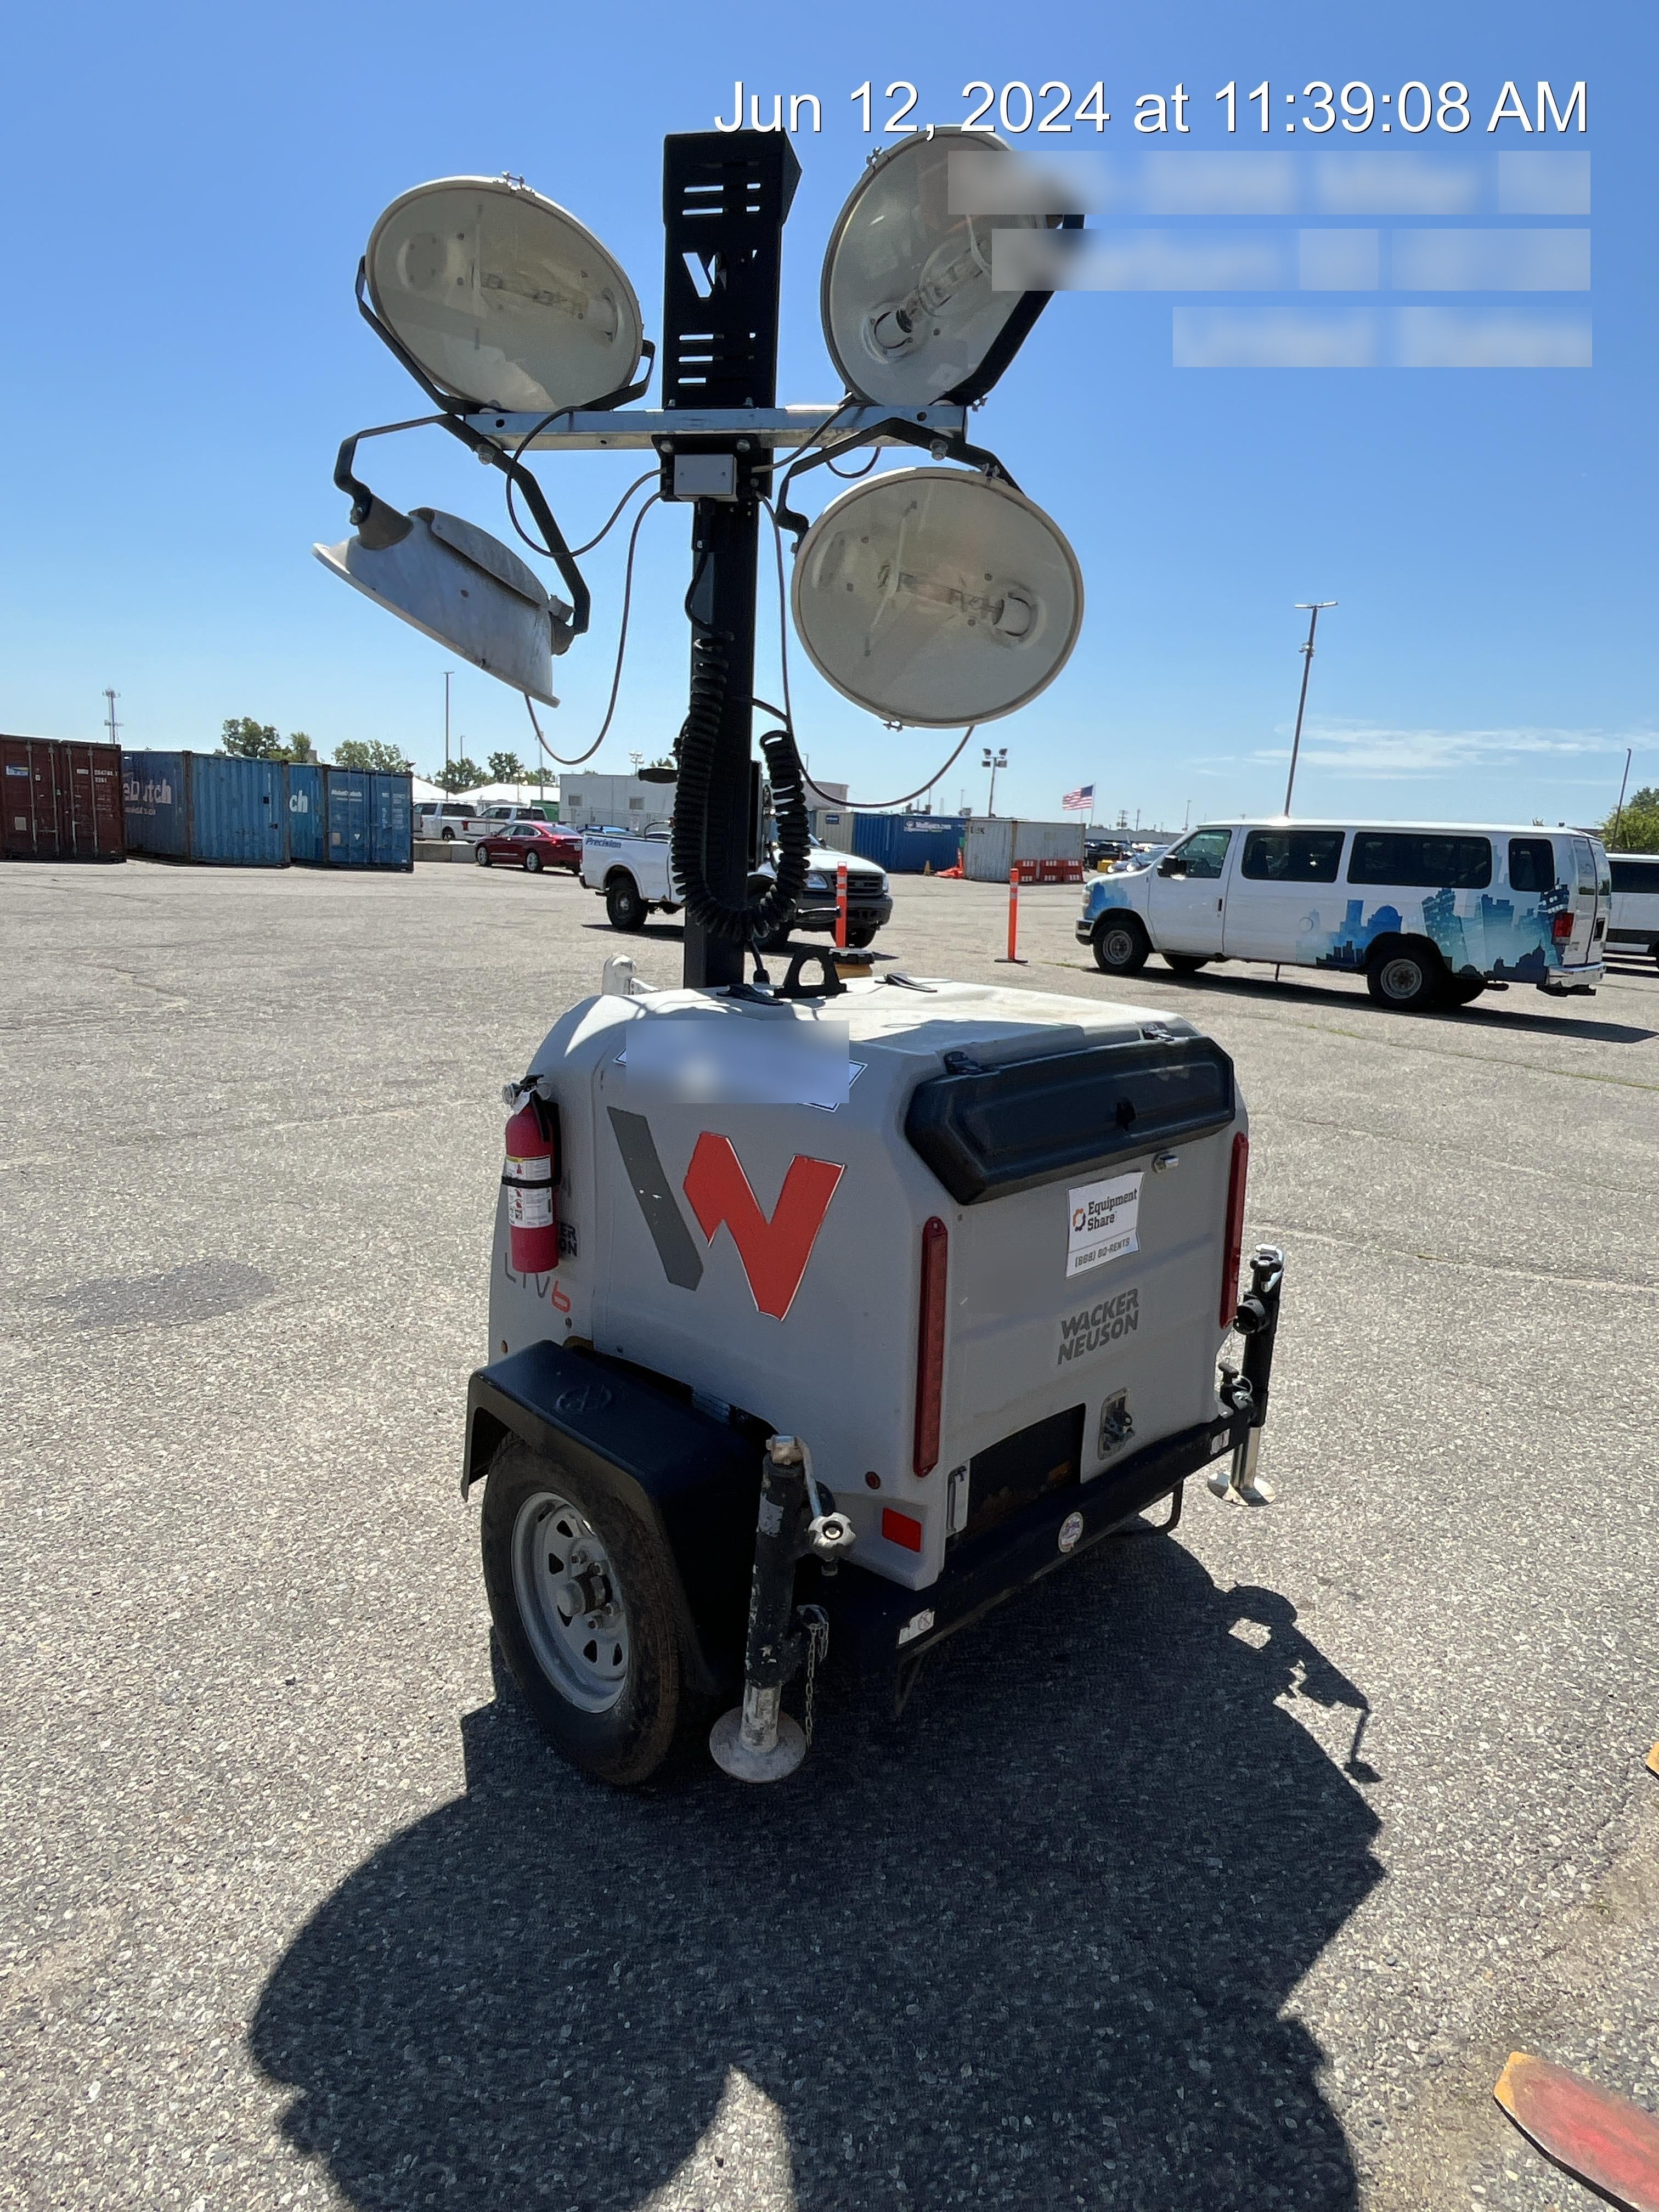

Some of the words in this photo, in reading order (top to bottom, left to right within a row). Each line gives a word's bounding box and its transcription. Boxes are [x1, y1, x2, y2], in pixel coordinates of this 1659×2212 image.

[585, 837, 622, 848] Precision
[1088, 1188, 1137, 1216] Equipment
[1087, 1213, 1115, 1232] Share
[1061, 1288, 1139, 1340] WACKER
[1057, 1310, 1139, 1365] NEUSON
